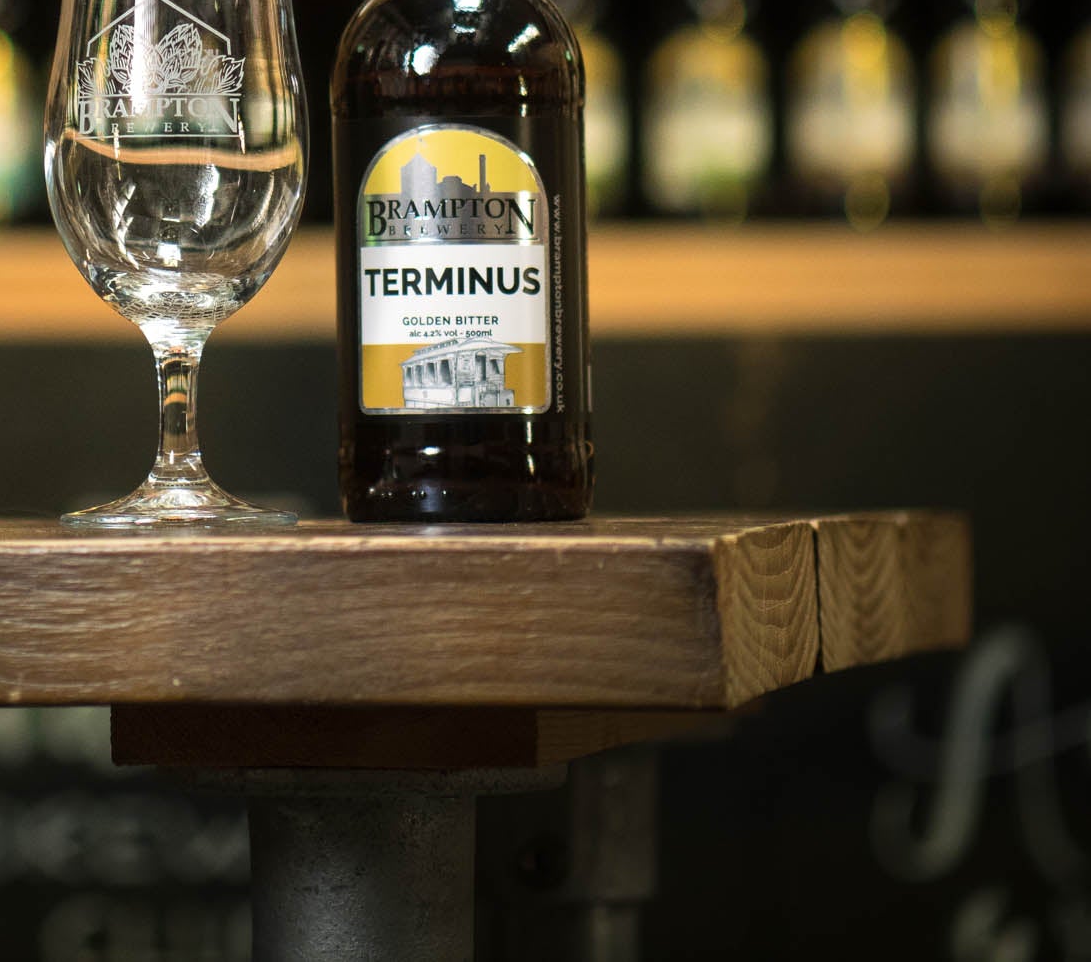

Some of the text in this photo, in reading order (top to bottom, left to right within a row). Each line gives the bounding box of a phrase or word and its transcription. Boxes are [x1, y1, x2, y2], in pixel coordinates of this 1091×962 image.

[366, 198, 537, 237] BRAMPTON
[388, 224, 505, 235] BREWERY
[364, 267, 541, 296] TERMINUS
[553, 194, 566, 414] www.bramptonbrewery.co.uk
[402, 315, 499, 326] GOLDEN BITTER
[409, 330, 422, 338] alc
[444, 329, 458, 337] vol
[465, 328, 493, 338] 500ml
